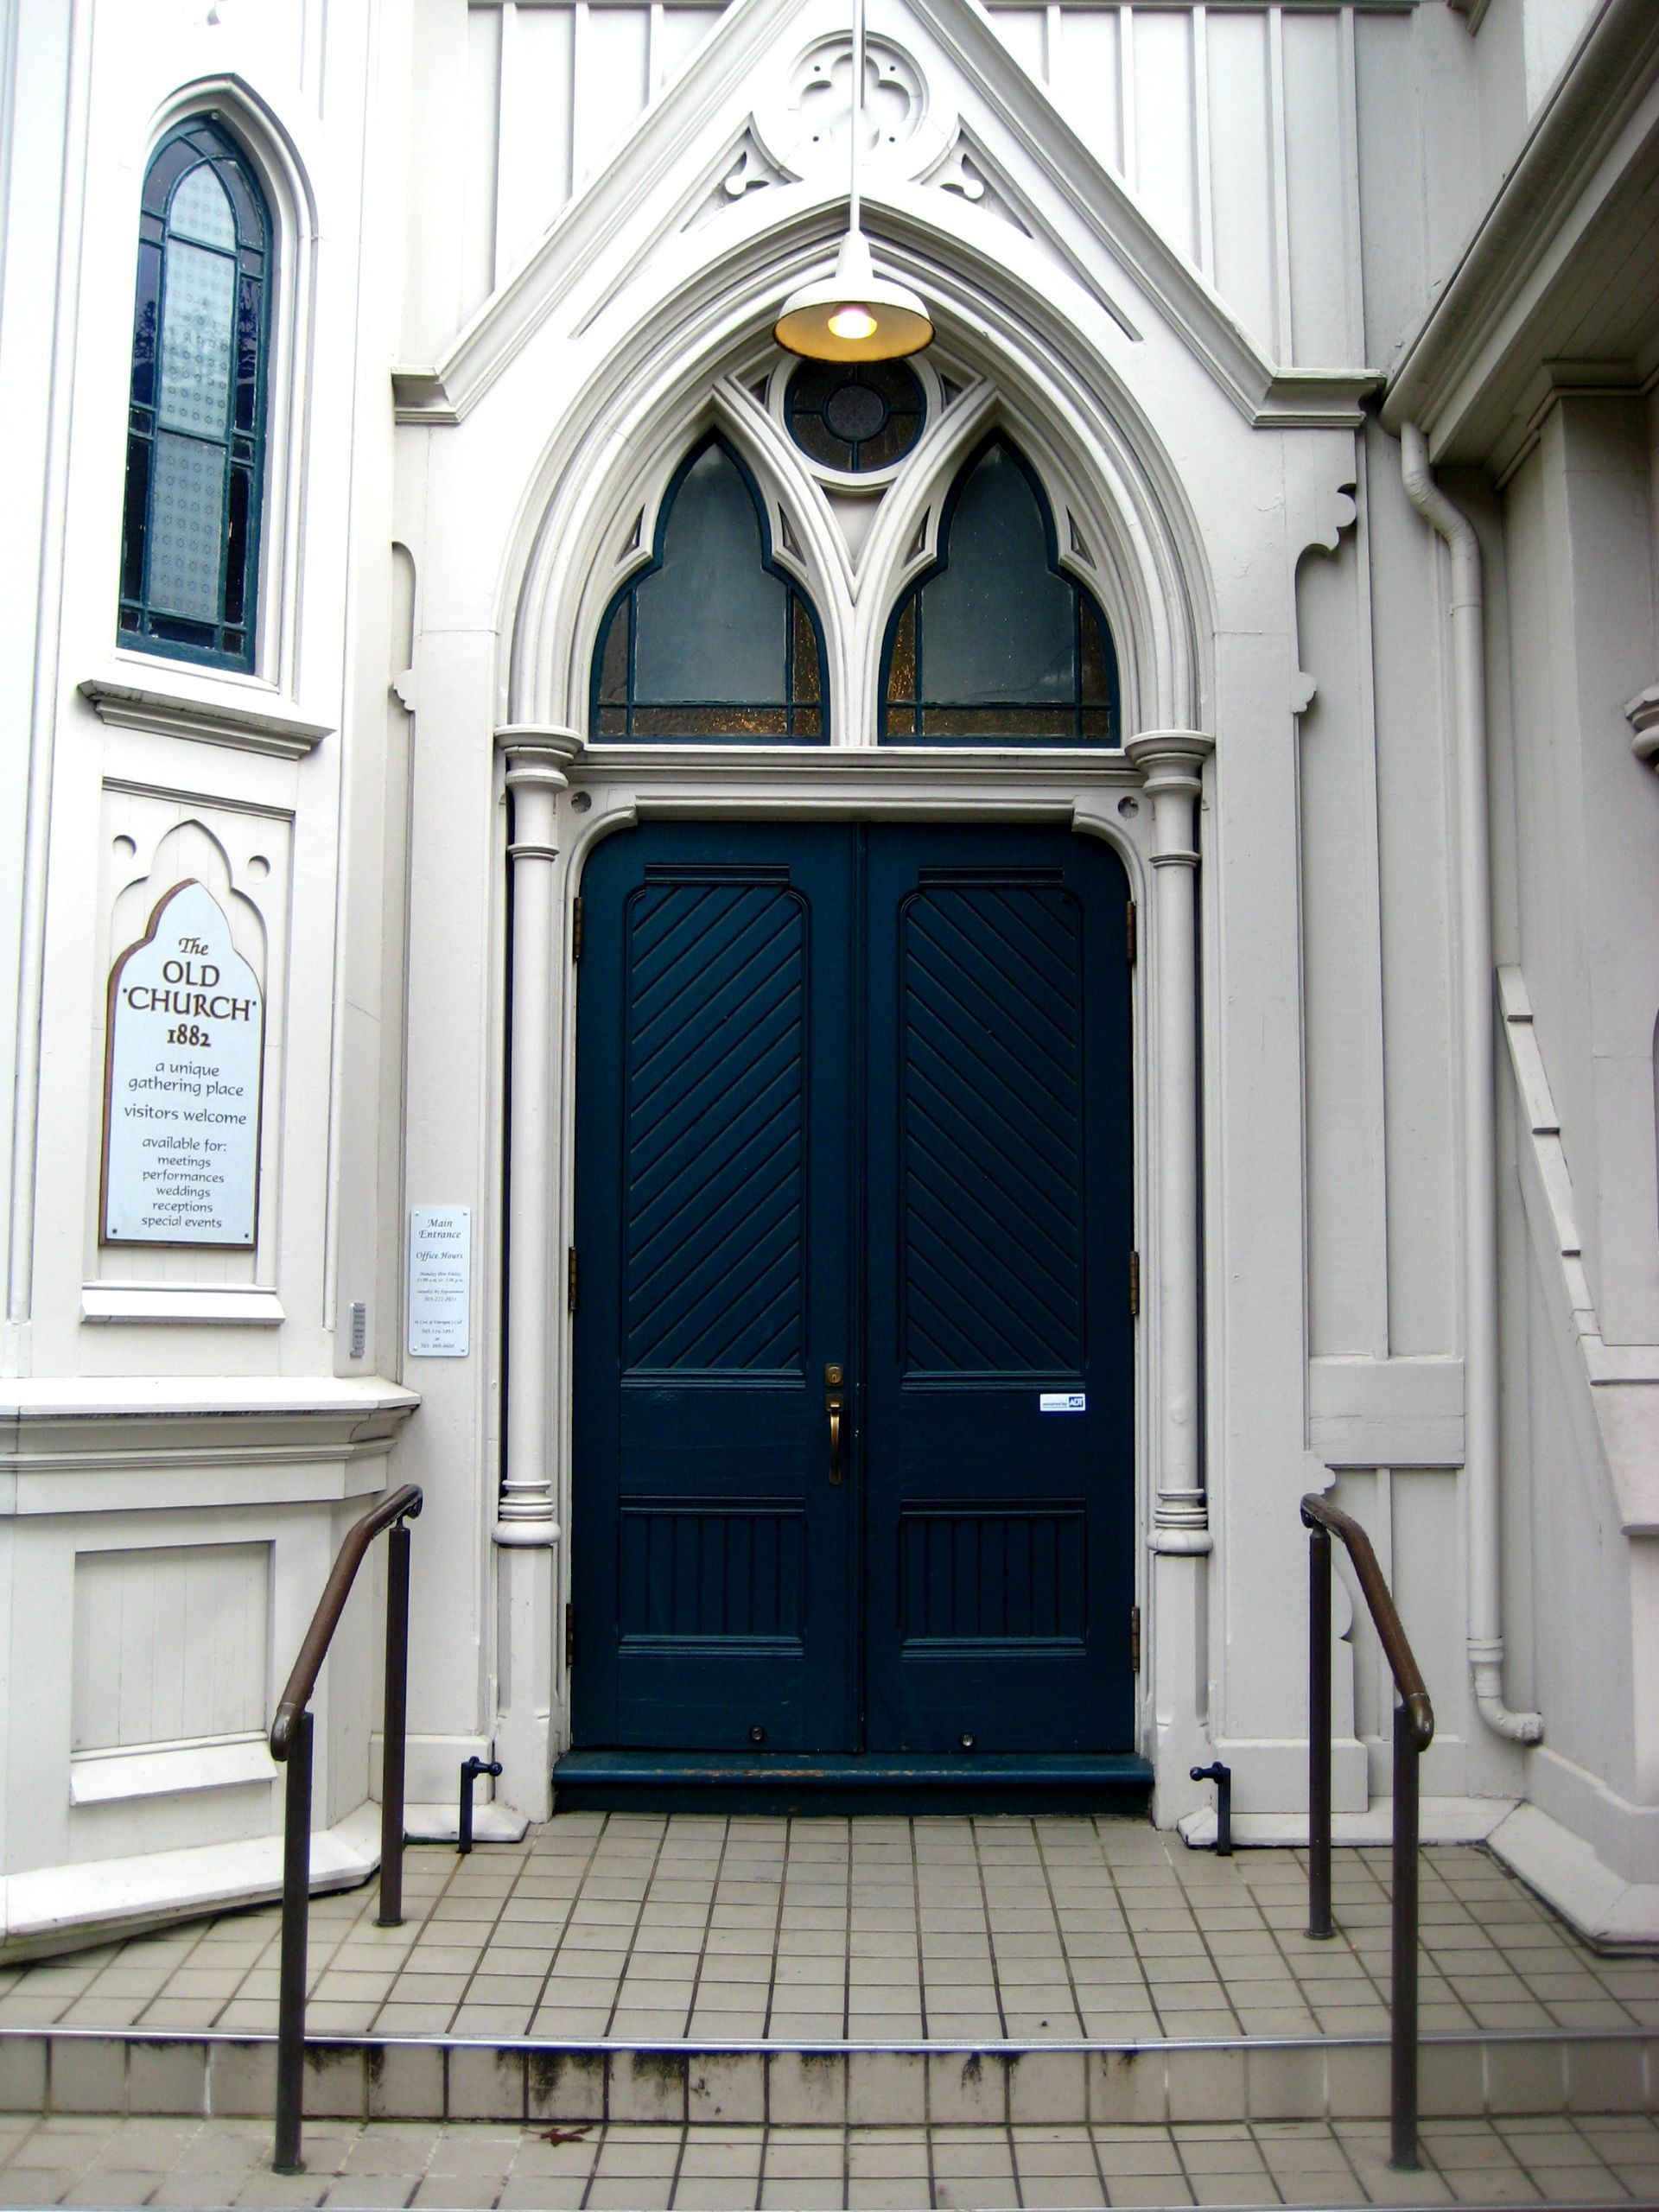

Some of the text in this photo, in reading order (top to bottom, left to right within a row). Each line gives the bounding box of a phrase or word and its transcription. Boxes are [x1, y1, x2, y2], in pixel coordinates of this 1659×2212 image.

[178, 937, 209, 956] The
[162, 960, 220, 987] OLD
[127, 986, 251, 1021] CHURCH
[167, 1023, 212, 1047] 1882
[156, 1061, 219, 1078] a unique
[128, 1077, 245, 1097] gathering place
[124, 1103, 247, 1125] visitors welcome
[142, 1136, 227, 1154] available for:
[157, 1155, 211, 1170] meetings
[143, 1169, 225, 1183] performances
[156, 1185, 211, 1200] weddings
[152, 1201, 213, 1214] receptions
[142, 1215, 222, 1228] special events
[427, 1218, 454, 1228] Main
[418, 1230, 461, 1239] Entrance
[416, 1250, 463, 1262] Office Hours
[1069, 1397, 1083, 1407] ADT
